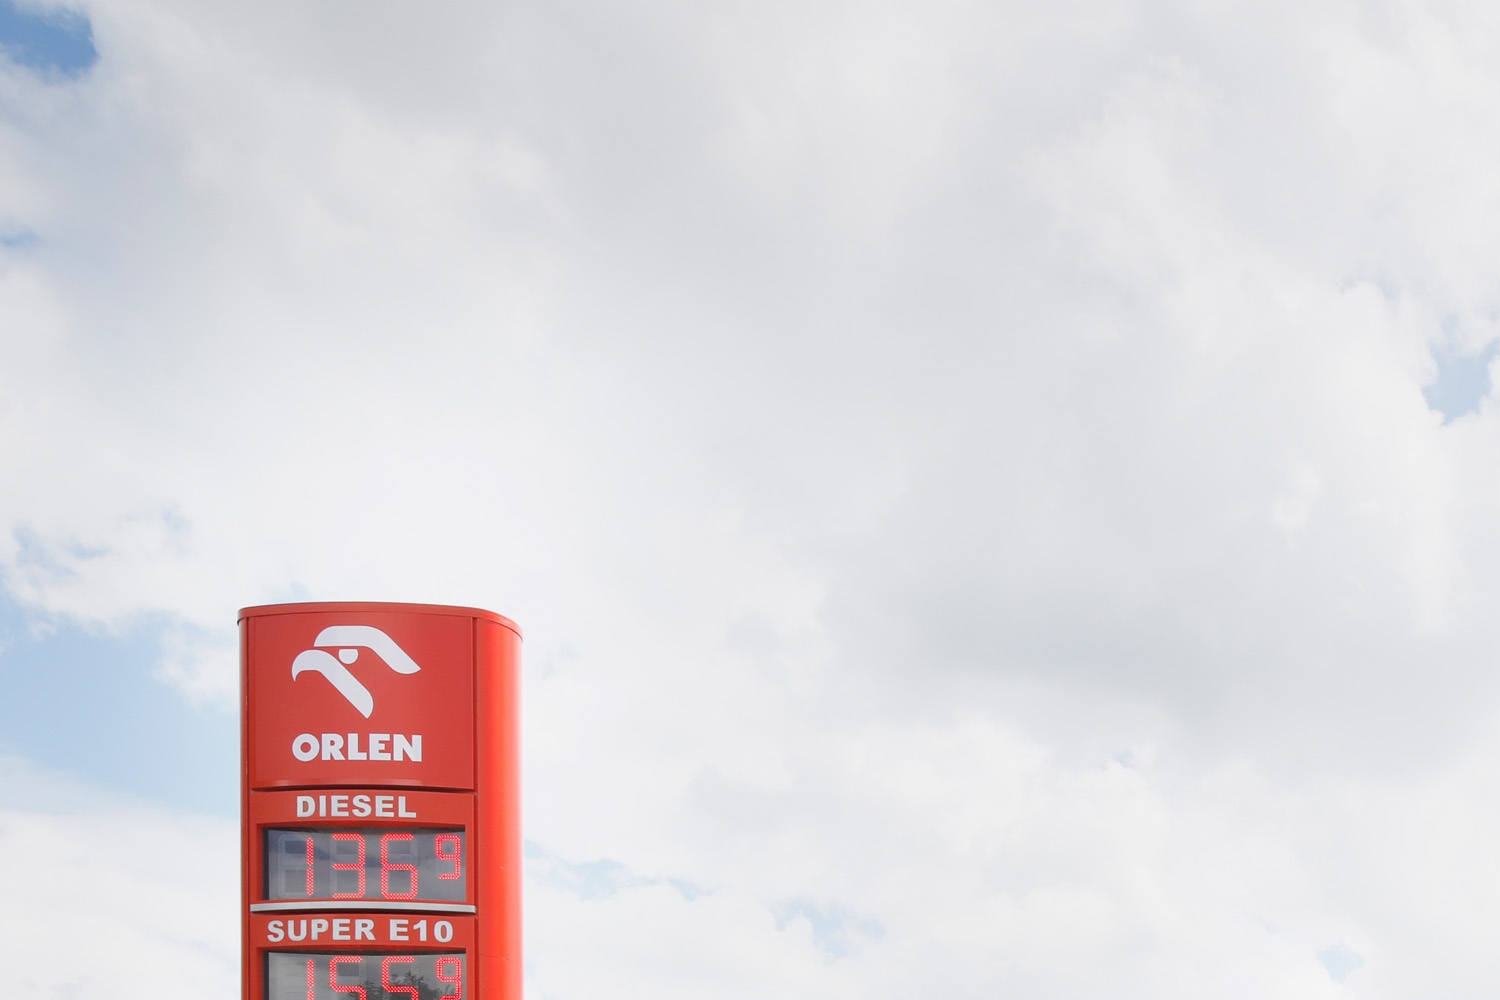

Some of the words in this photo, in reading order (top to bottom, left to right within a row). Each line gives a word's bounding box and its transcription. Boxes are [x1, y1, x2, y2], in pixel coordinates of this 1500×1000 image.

[292, 733, 423, 763] ORLEN
[296, 795, 417, 818] DIESEL
[267, 918, 376, 943] SUPER
[390, 919, 454, 943] E10
